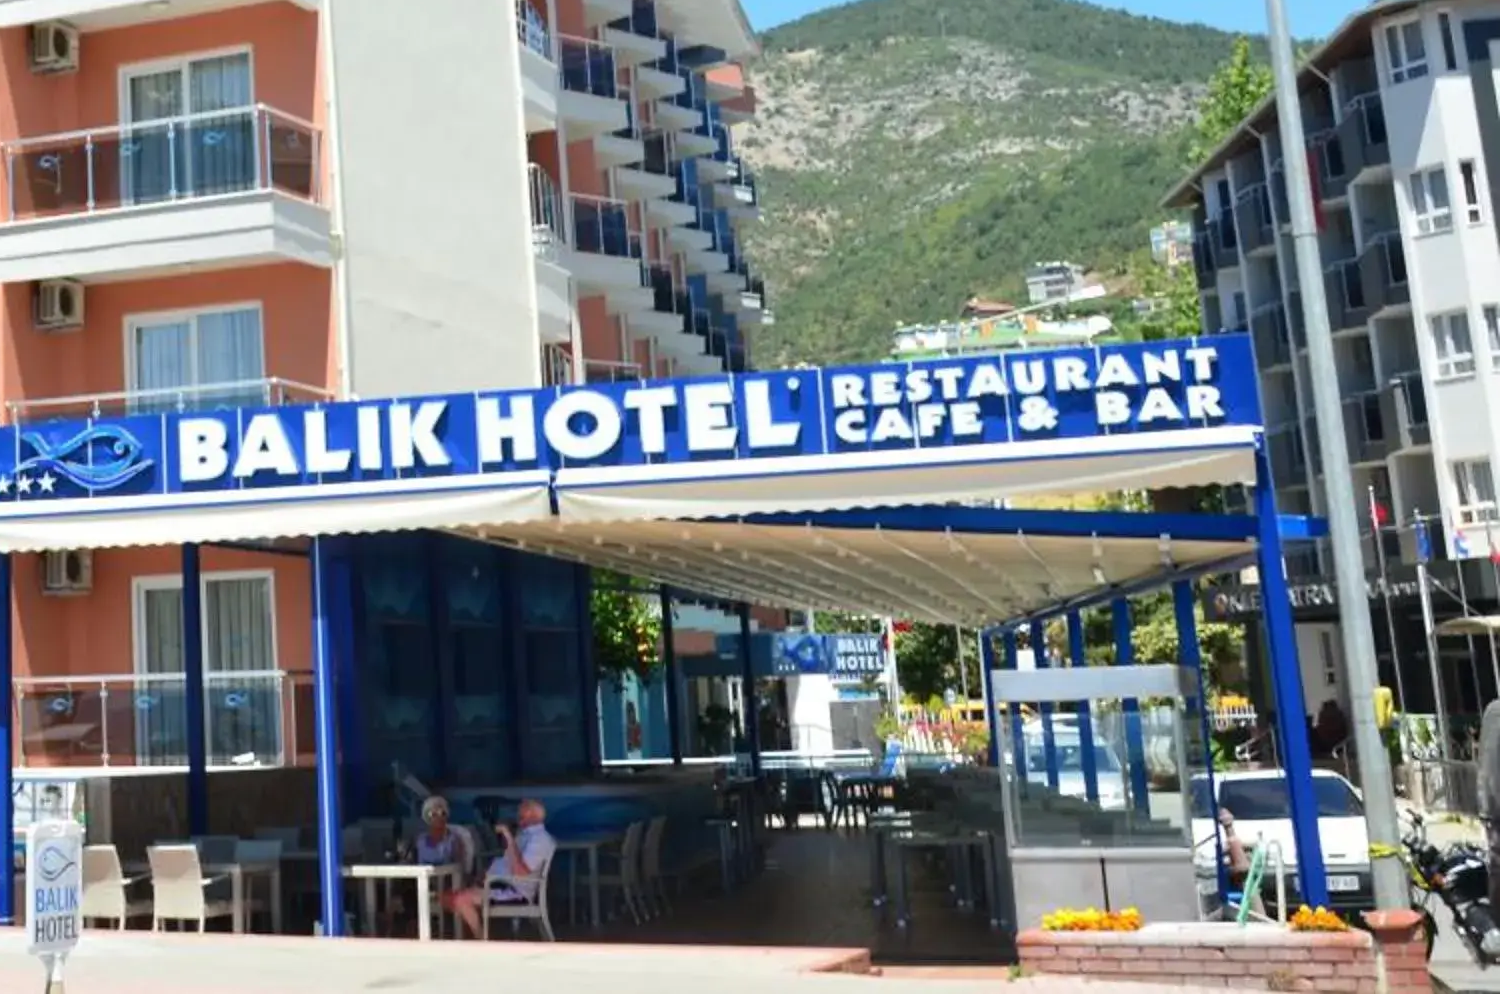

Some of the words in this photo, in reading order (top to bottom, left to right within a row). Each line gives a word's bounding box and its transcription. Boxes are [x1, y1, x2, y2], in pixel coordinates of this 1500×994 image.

[831, 347, 1218, 408] RESTAURANT
[834, 402, 983, 443] CAFE
[1018, 396, 1059, 431] &
[1095, 385, 1224, 425] BAR
[177, 400, 451, 482] BALIK
[475, 380, 801, 464] HOTEL
[836, 638, 879, 654] BALIK
[835, 655, 884, 671] HOTEL
[35, 886, 79, 913] BALIK
[35, 914, 80, 943] HOTEL
